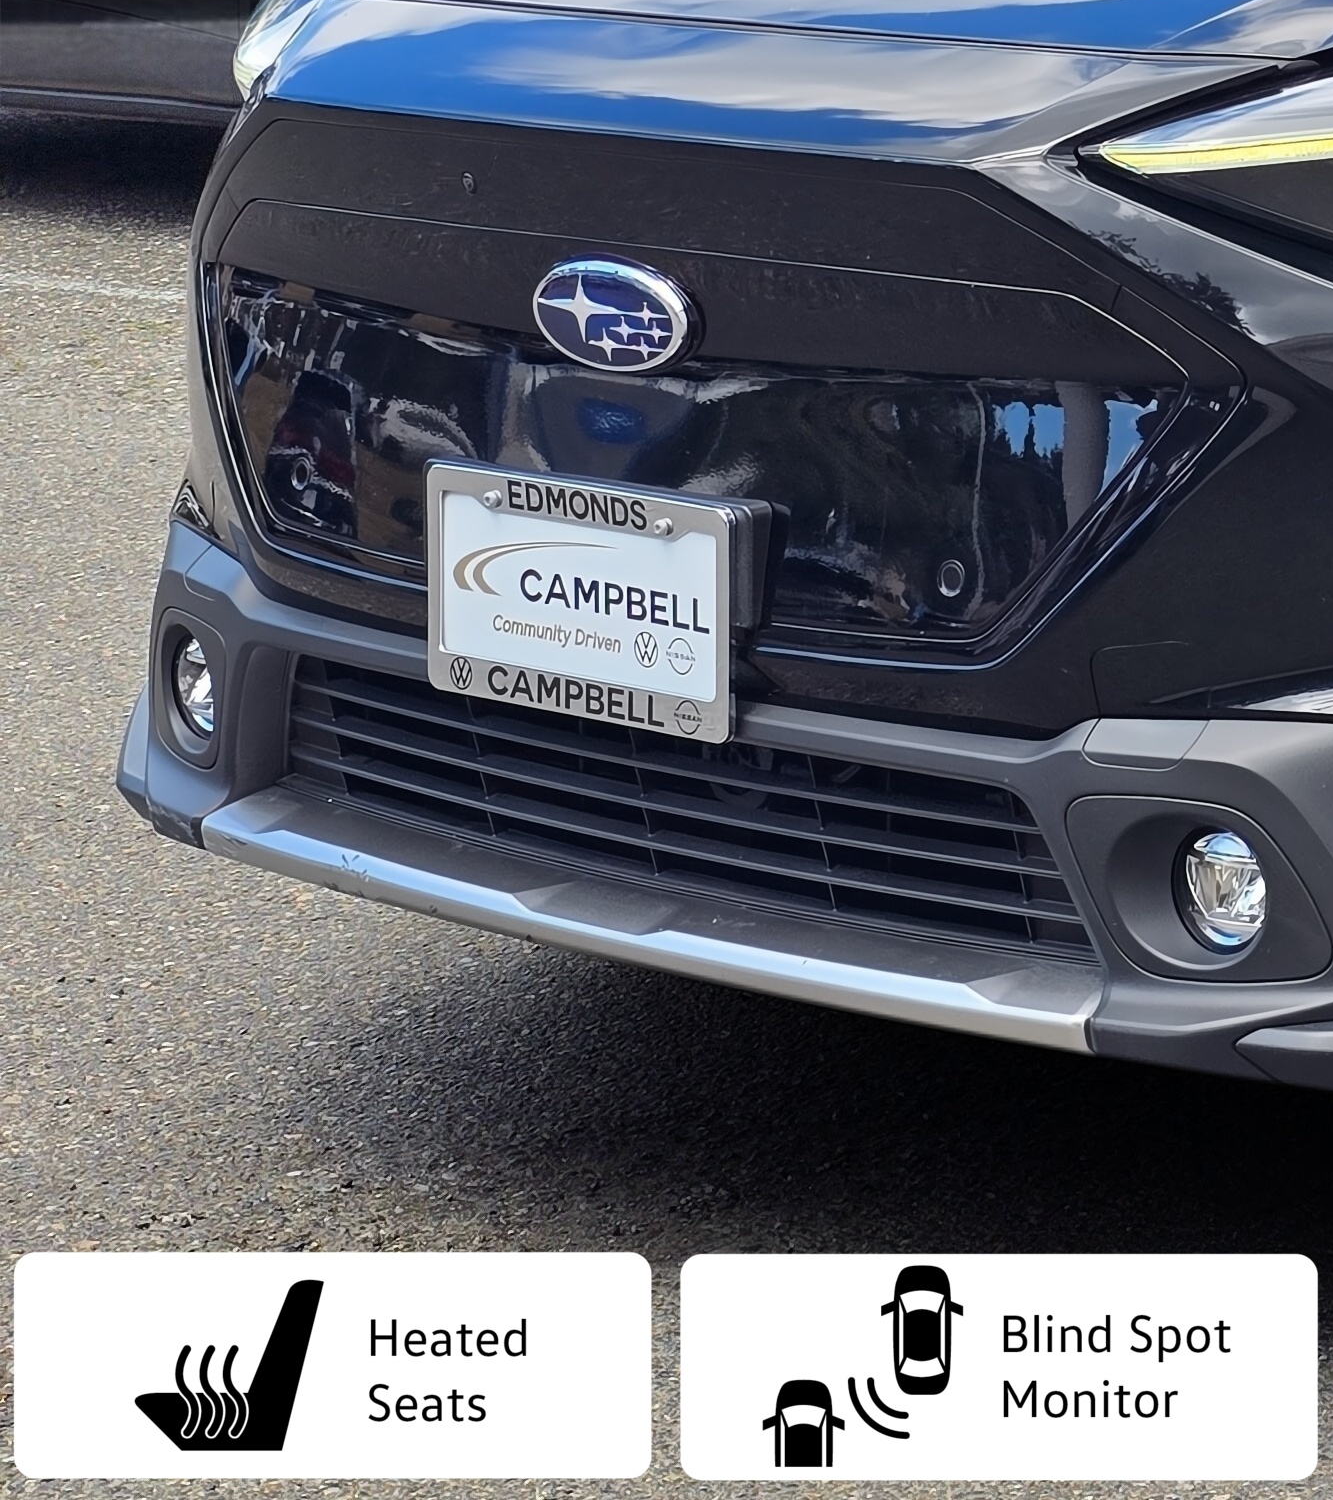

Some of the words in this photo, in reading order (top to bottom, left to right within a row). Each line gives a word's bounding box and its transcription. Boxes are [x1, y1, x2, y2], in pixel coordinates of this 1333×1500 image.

[506, 479, 648, 531] EDMONDS
[519, 568, 711, 635] CAMPBELL
[492, 614, 571, 648] Community
[574, 628, 622, 654] Driven
[486, 665, 665, 727] CAMPBELL
